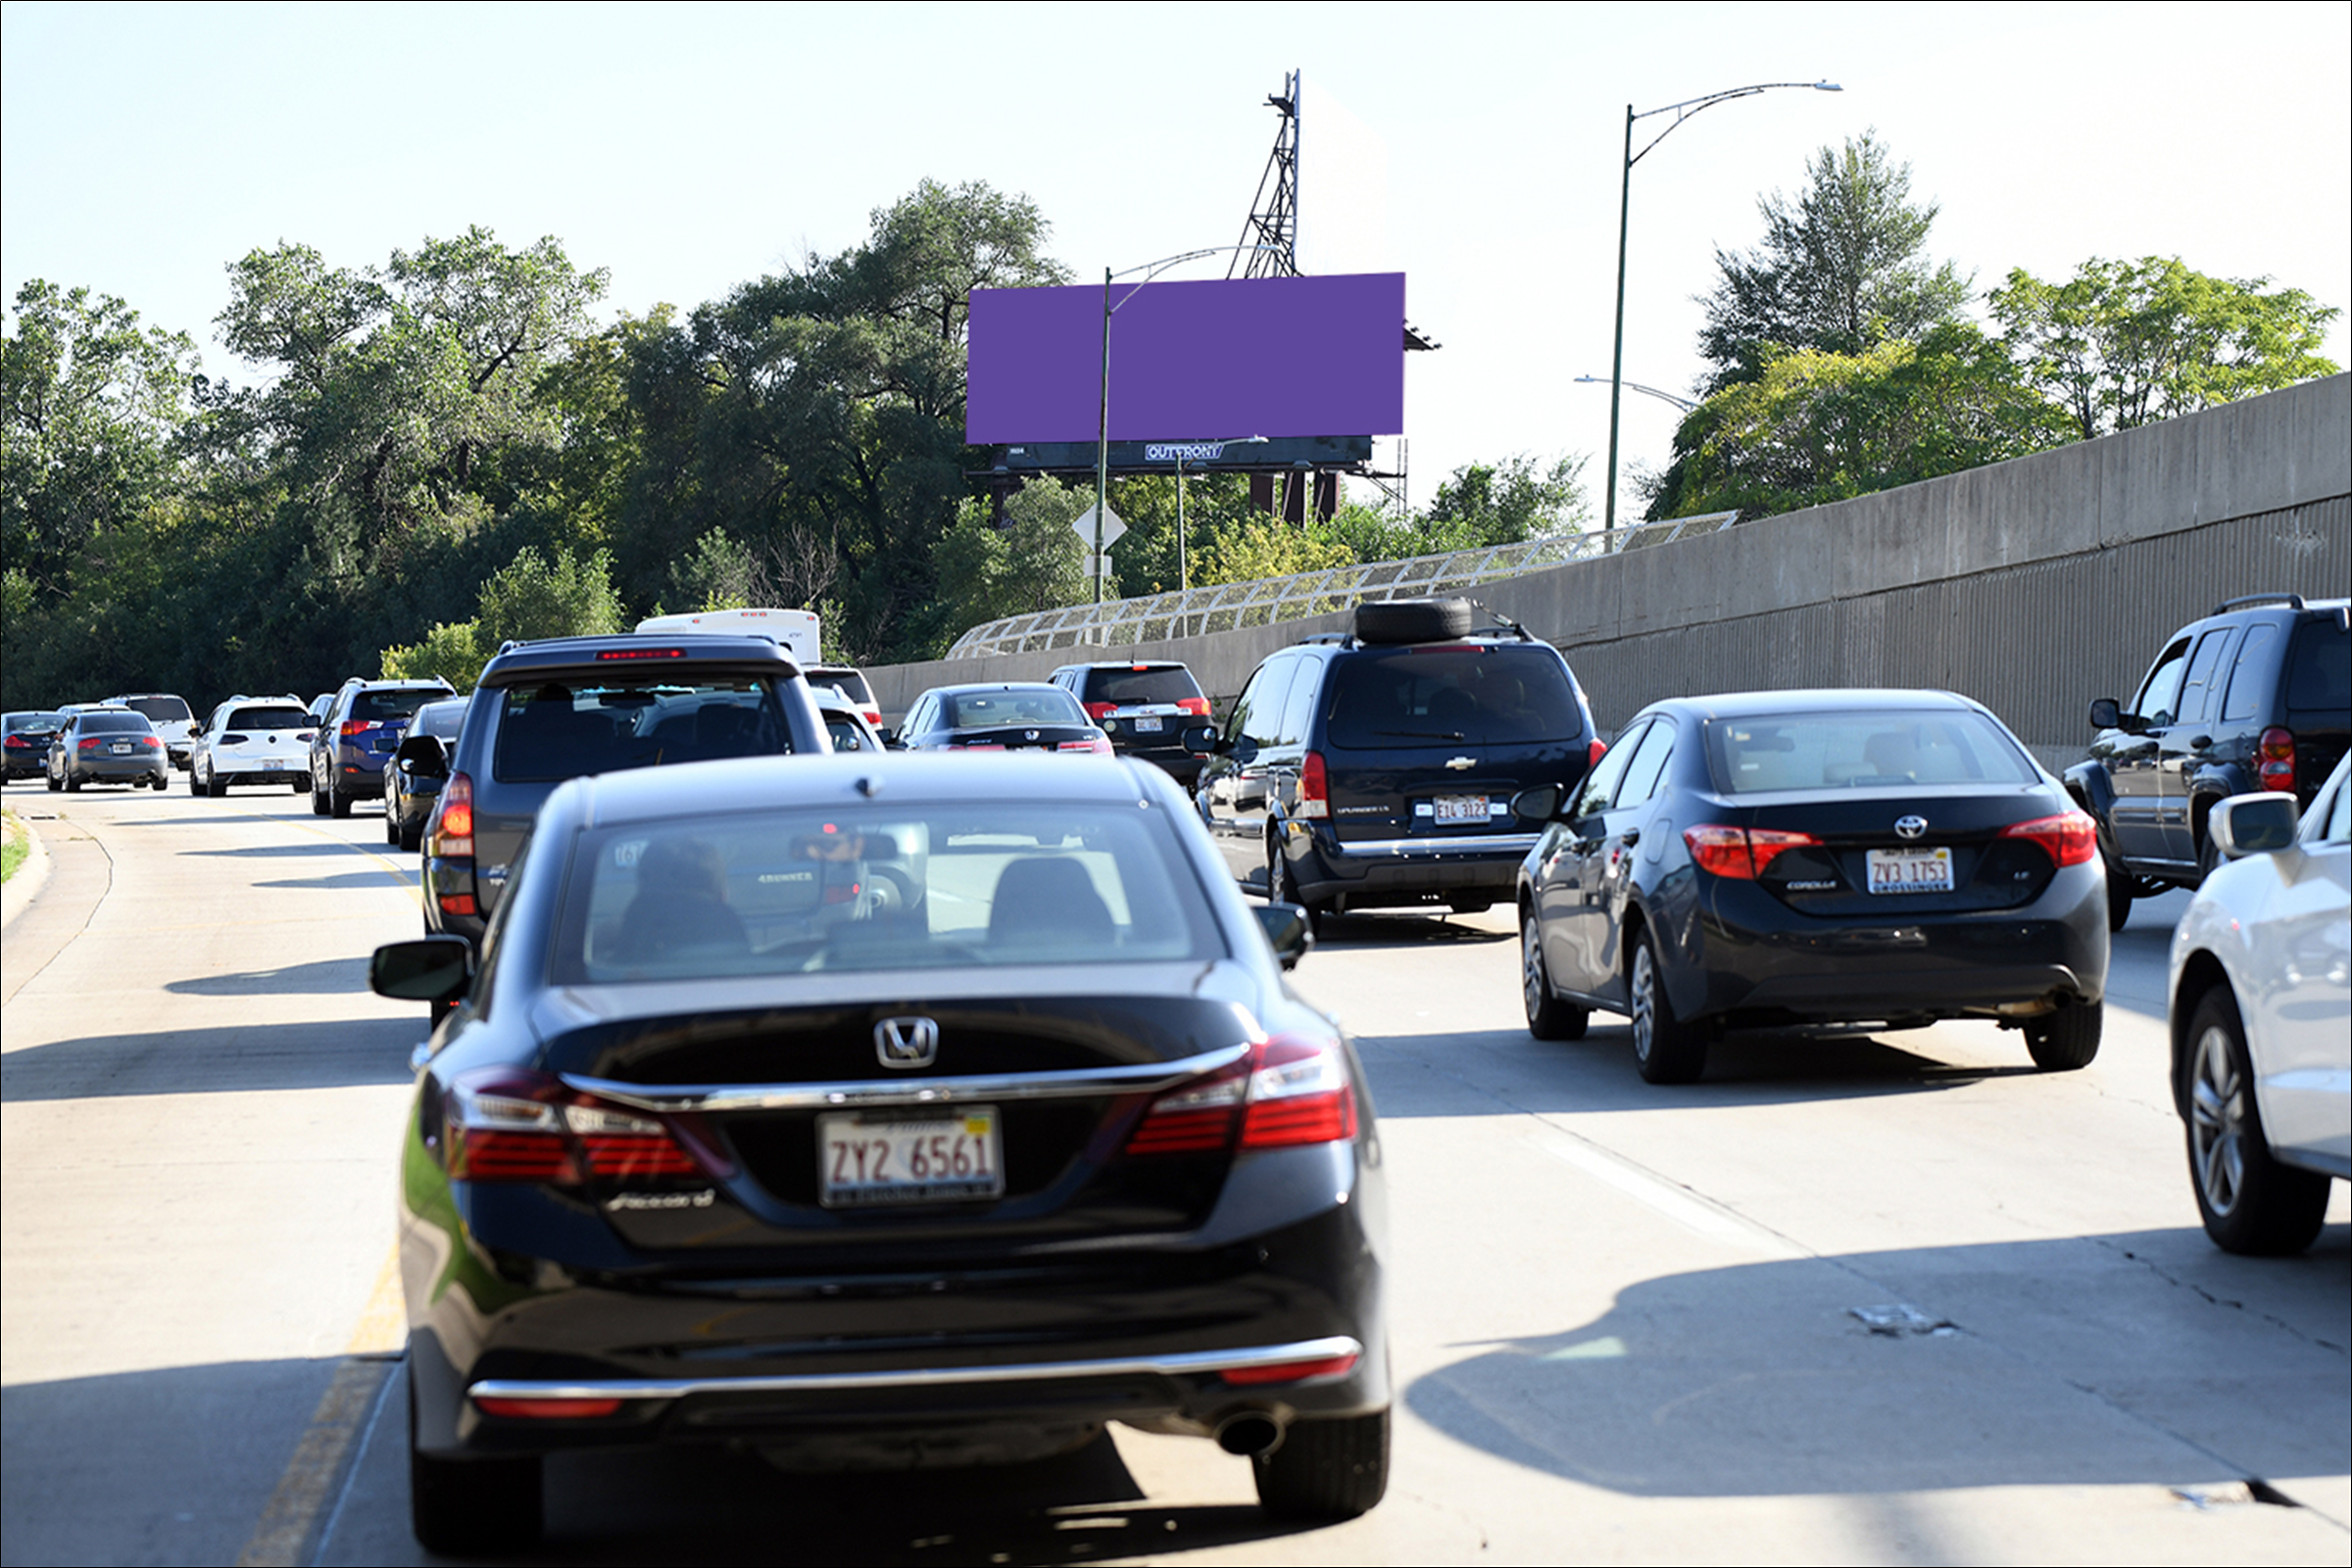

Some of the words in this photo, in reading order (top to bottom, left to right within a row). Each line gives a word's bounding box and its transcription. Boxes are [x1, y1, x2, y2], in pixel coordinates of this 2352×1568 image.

[1149, 445, 1217, 459] OUTFRONT
[1462, 803, 1488, 817] 3123
[1873, 861, 1901, 884] ZV3
[1911, 860, 1948, 882] 1753
[831, 1140, 892, 1183] ZY2
[911, 1134, 990, 1179] 6561
